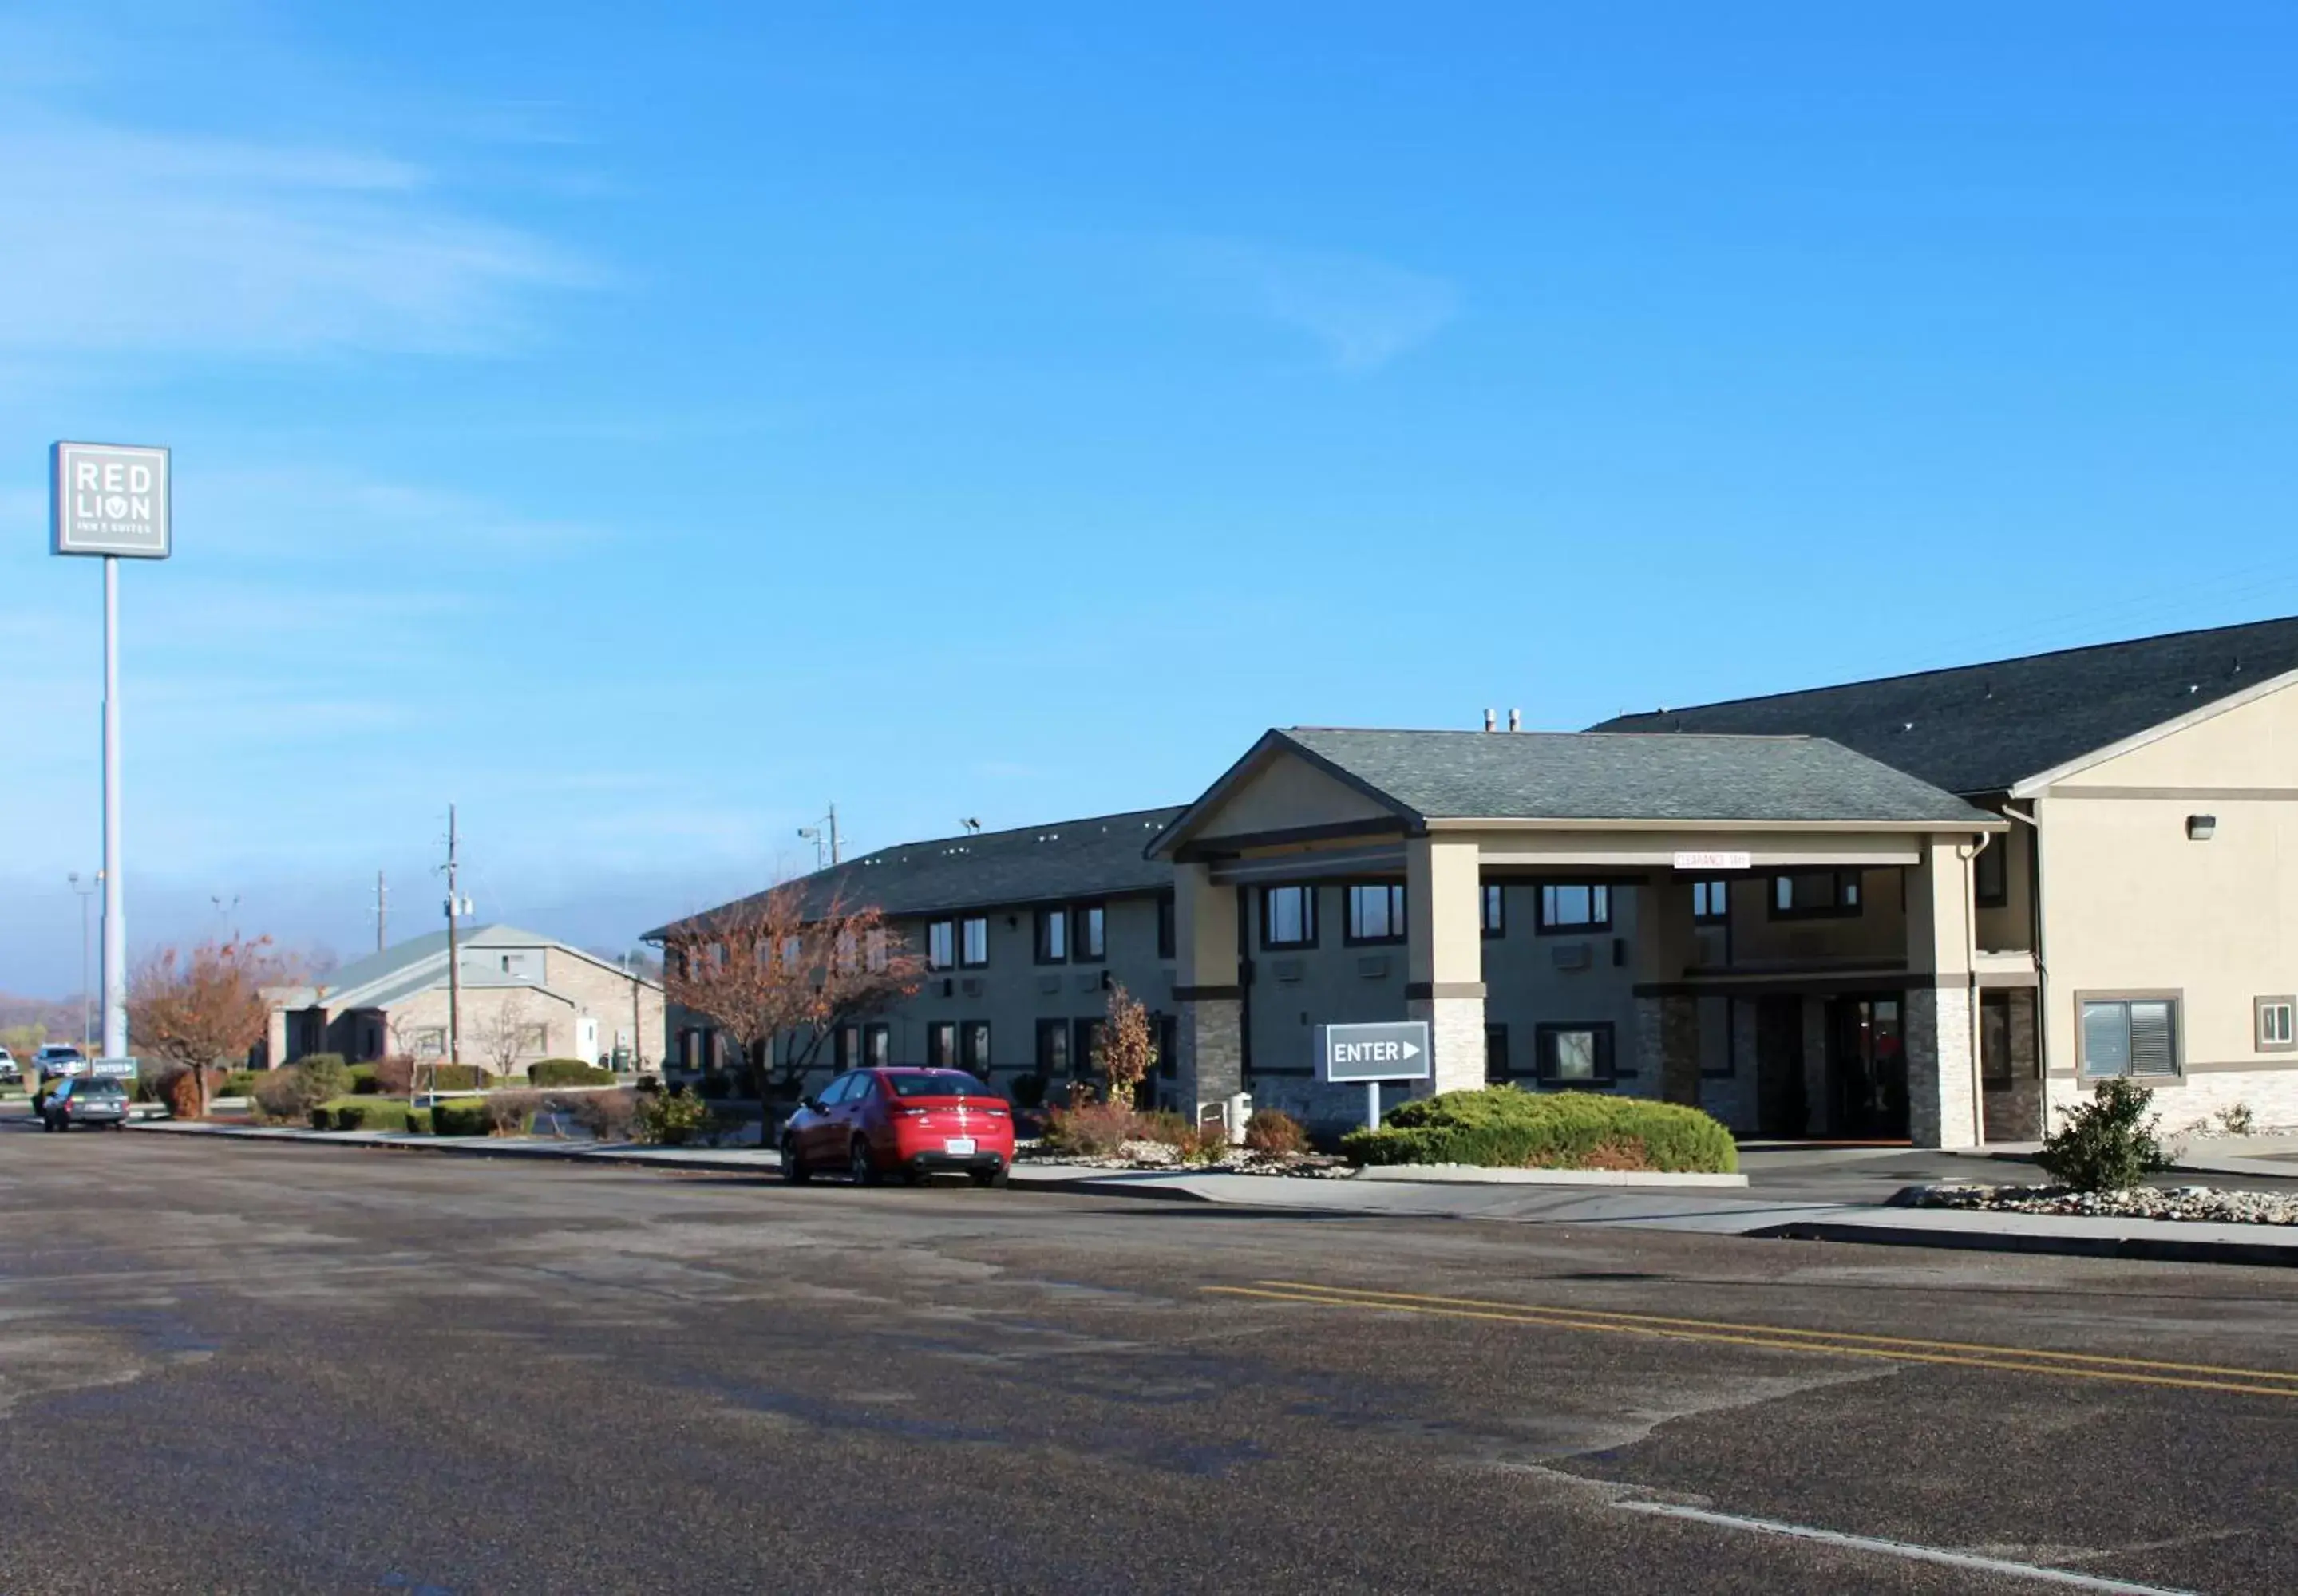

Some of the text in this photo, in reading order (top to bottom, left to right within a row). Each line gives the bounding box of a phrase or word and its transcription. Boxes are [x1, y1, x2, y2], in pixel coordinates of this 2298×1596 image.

[77, 461, 151, 493] RED
[77, 493, 151, 520] LION
[1335, 1041, 1399, 1062] ENTER
